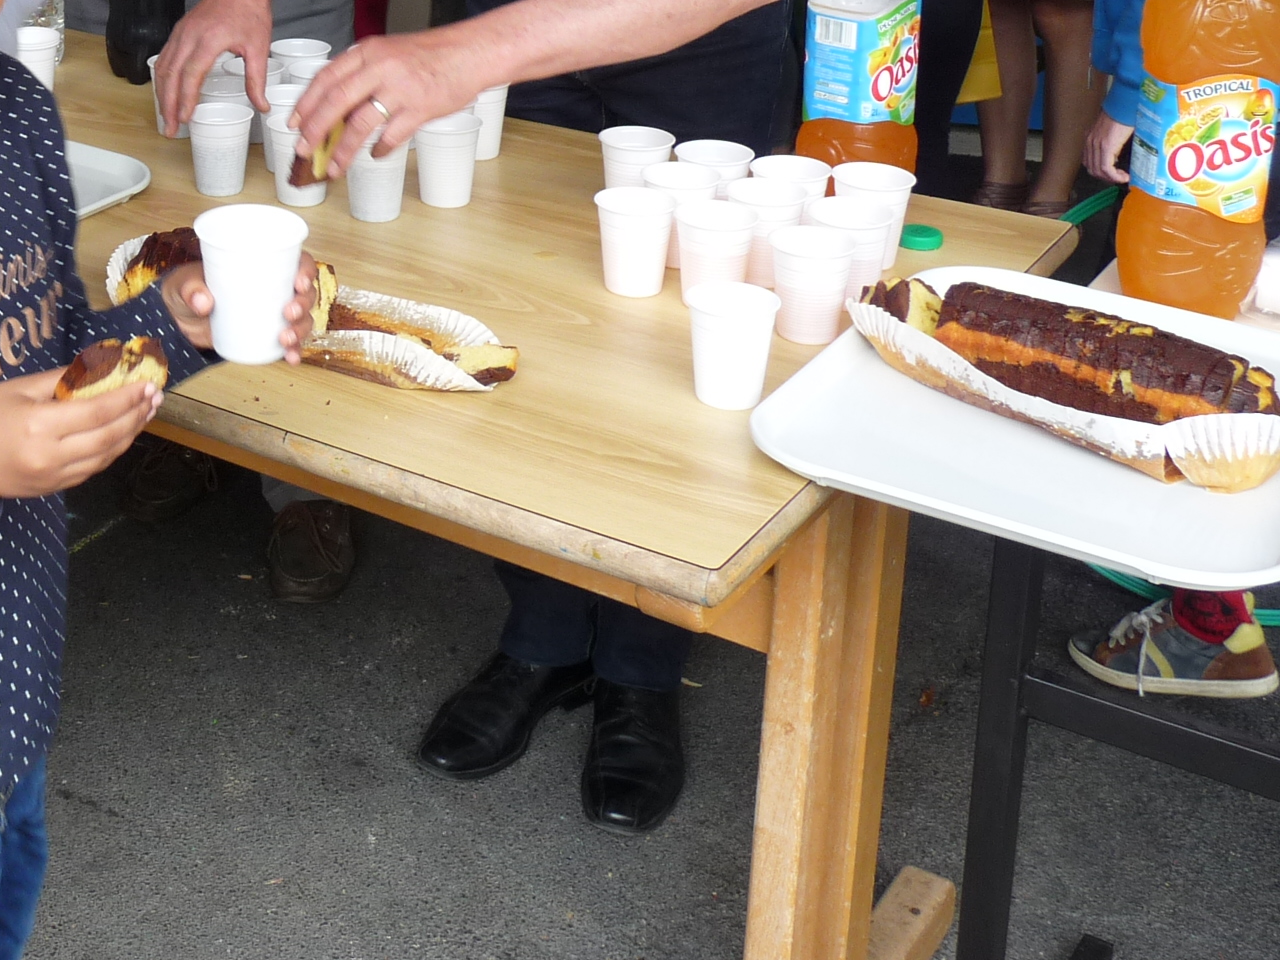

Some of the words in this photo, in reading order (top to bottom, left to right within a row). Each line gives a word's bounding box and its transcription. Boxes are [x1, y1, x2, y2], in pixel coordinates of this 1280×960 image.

[871, 33, 919, 102] Oasi
[1184, 81, 1252, 101] TROPICAL
[1168, 120, 1275, 182] Oasis
